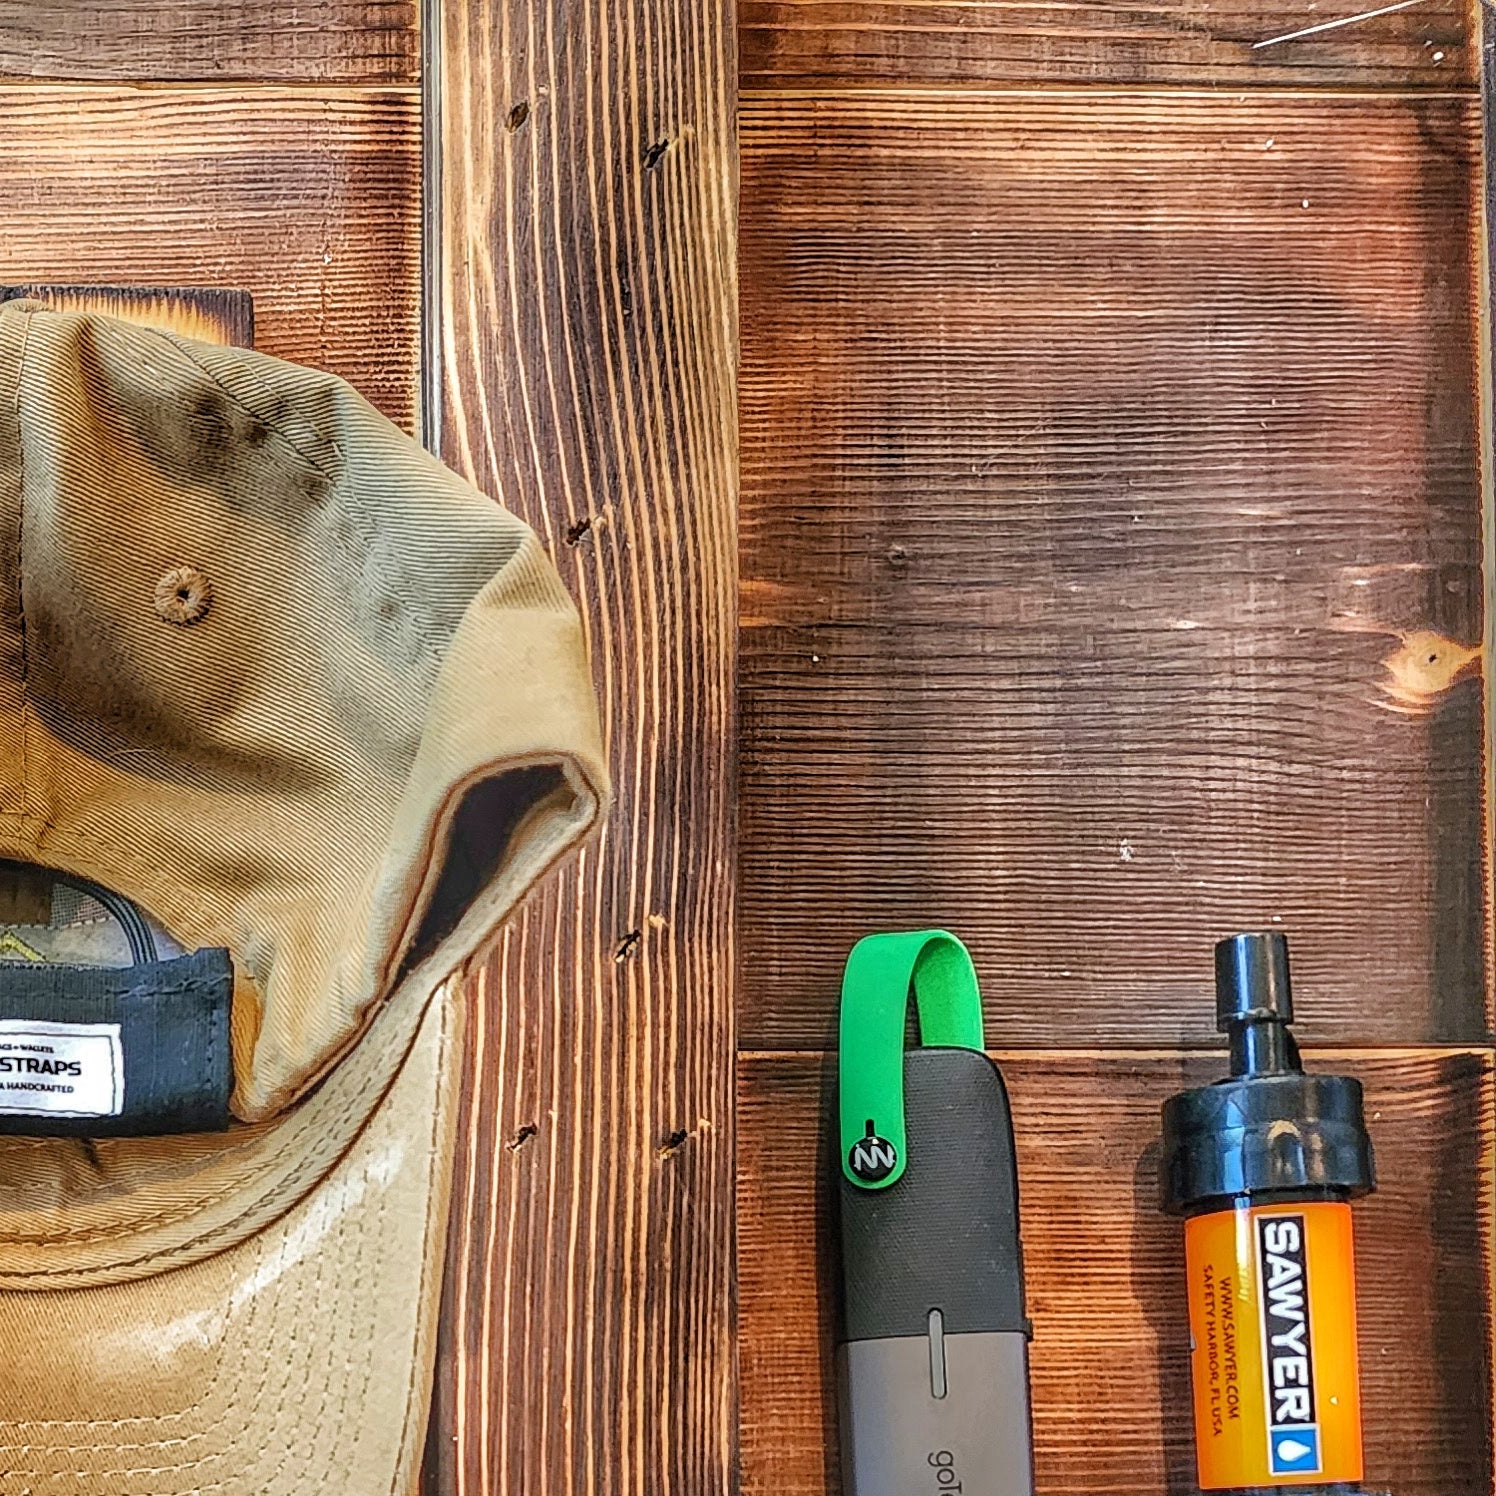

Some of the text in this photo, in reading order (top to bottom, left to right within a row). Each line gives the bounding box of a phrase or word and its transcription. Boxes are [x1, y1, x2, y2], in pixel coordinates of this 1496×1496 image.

[6, 1082, 74, 1094] HANDCRAFTED
[1203, 1264, 1216, 1318] SAFETY
[1211, 1406, 1223, 1437] USA
[1219, 1276, 1240, 1420] WWW.SAWYER.COM
[1264, 1220, 1311, 1423] SAWYER
